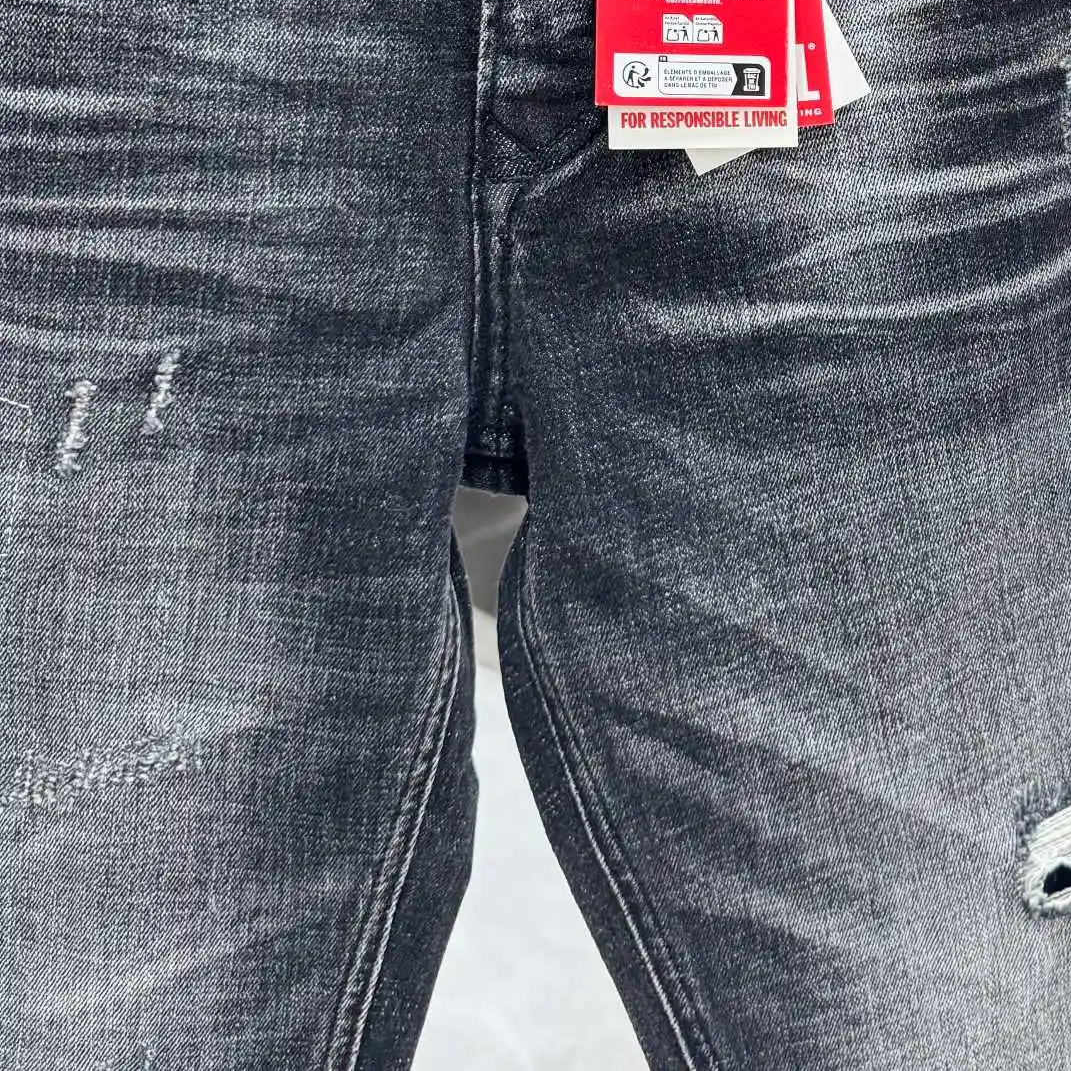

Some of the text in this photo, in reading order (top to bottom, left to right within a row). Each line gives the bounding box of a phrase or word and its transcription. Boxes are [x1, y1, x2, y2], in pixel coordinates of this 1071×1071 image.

[800, 108, 822, 117] ING
[621, 111, 787, 128] FOR RESPONSIBLE LIVING
